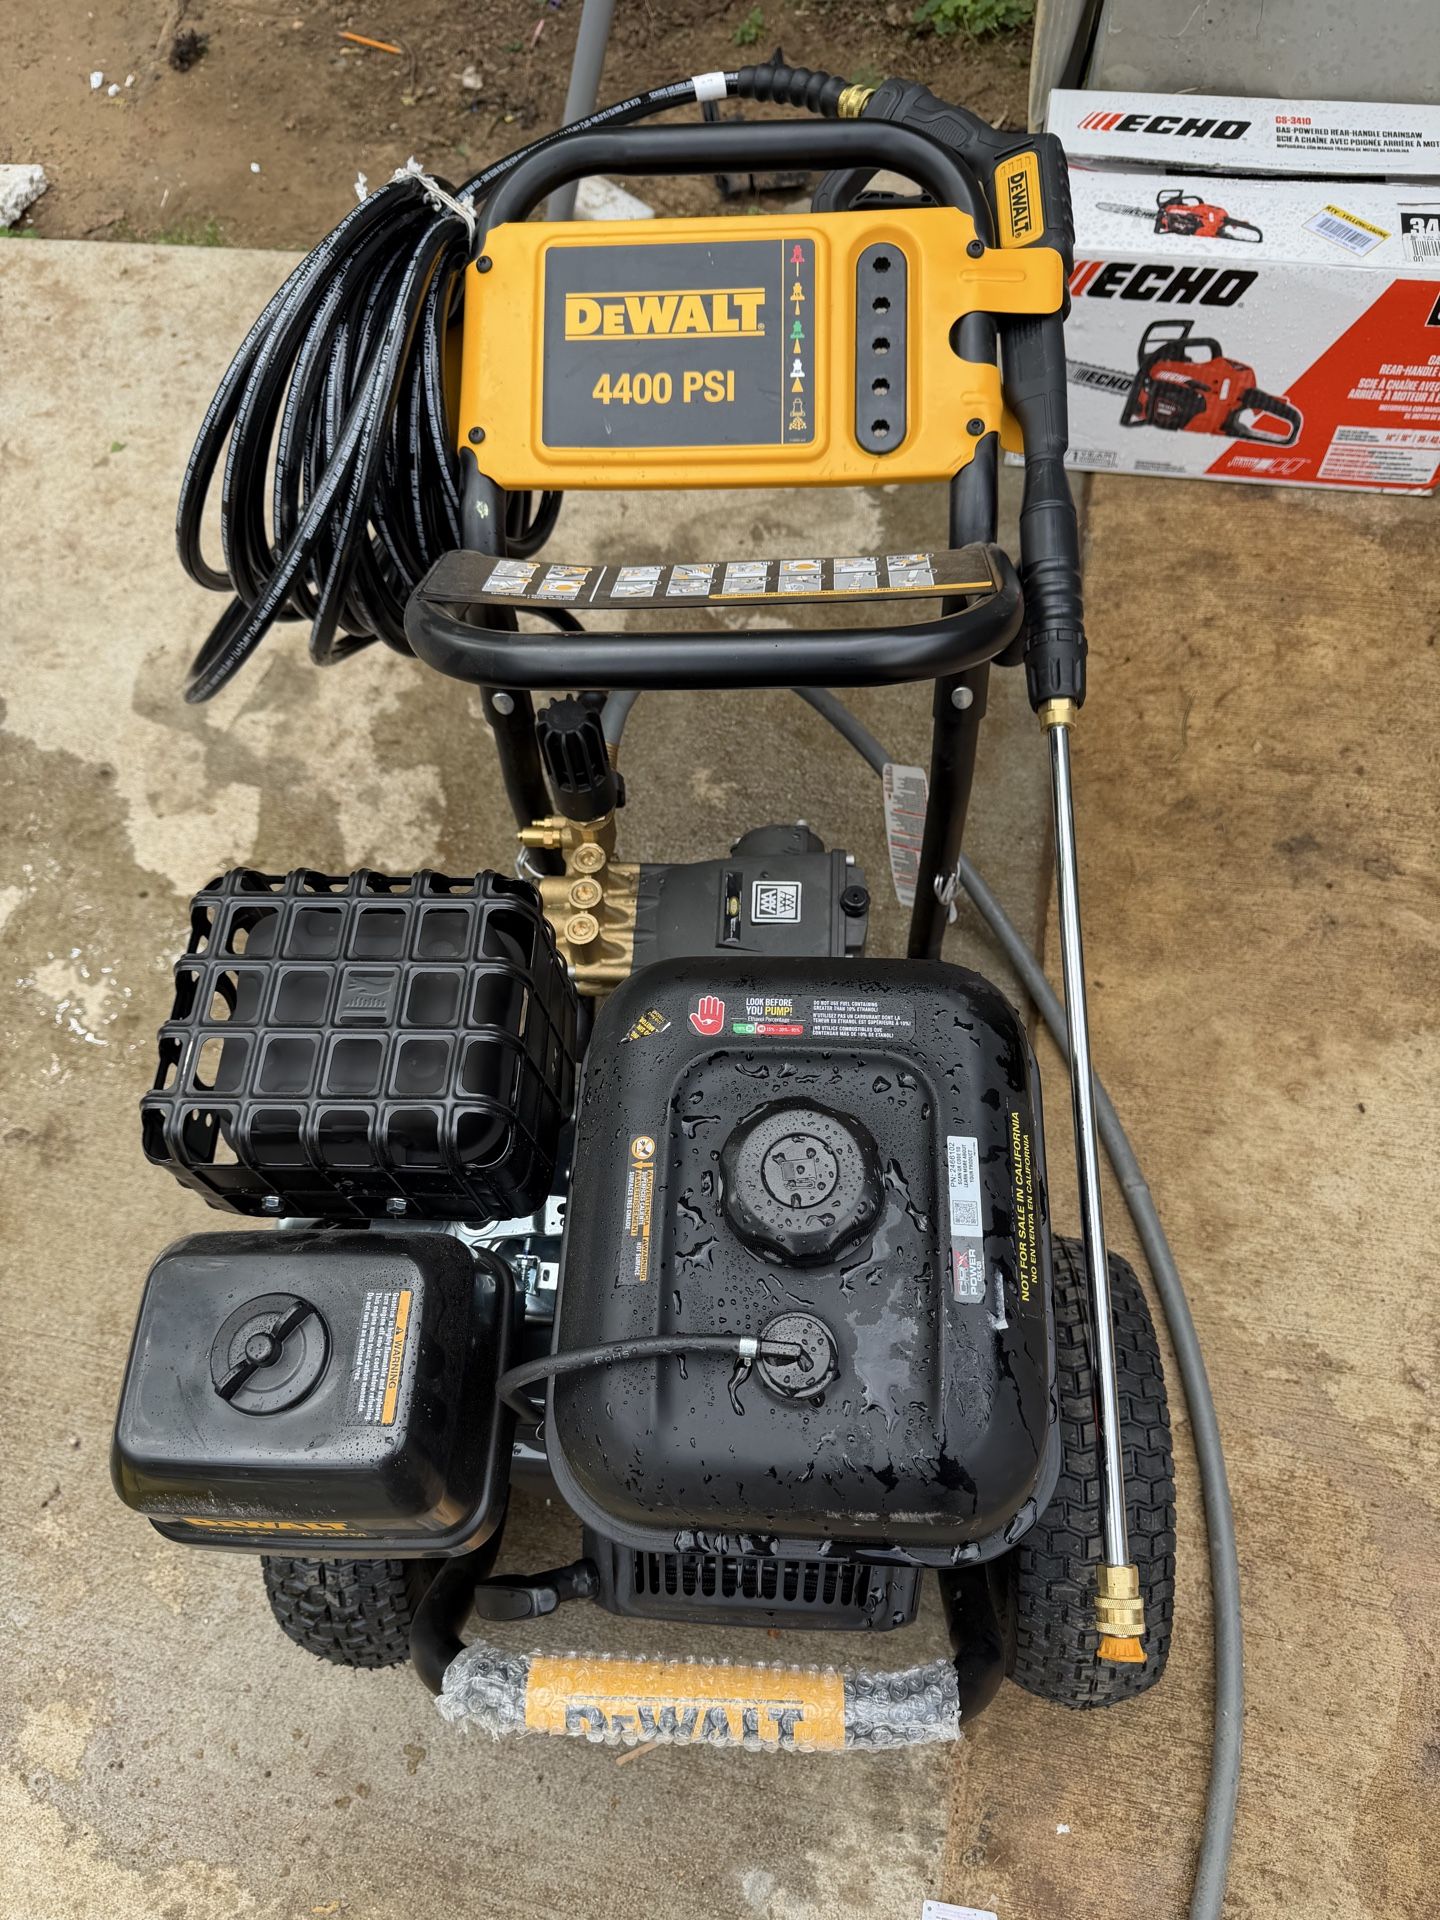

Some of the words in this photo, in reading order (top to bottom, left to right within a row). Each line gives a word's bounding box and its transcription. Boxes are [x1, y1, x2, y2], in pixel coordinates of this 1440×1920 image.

[1114, 114, 1252, 140] ECHO
[1330, 129, 1380, 137] REAR-HANDLE
[1087, 262, 1259, 307] ECHO
[565, 292, 765, 336] DEWALT
[1379, 364, 1439, 377] REAR-HANDLE
[592, 372, 672, 404] 4400
[683, 370, 734, 403] PSI
[302, 512, 321, 540] SURFACES
[746, 998, 764, 1006] LOOK
[765, 998, 793, 1006] BEFORE
[746, 1006, 762, 1016] YOU
[764, 1006, 793, 1016] PUMP!
[1011, 1112, 1023, 1185] CALIFORNIA
[1023, 1134, 1033, 1193] CALIFORNIA
[632, 1179, 640, 1235] AVERTISSEMENT
[644, 1179, 653, 1226] ADVERTENCIA
[1016, 1188, 1024, 1202] IN
[1027, 1196, 1033, 1210] EN
[1017, 1205, 1026, 1239] SALE
[1019, 1242, 1028, 1269] FOR
[1030, 1247, 1037, 1264] EN
[969, 1249, 978, 1295] POWER
[1031, 1266, 1038, 1284] NO
[1020, 1272, 1030, 1301] NOT
[371, 1306, 379, 1325] engine
[380, 1306, 388, 1326] engine
[356, 1338, 366, 1365] enclosed
[366, 1344, 374, 1359] toxic
[374, 1358, 382, 1370] cool
[388, 1340, 403, 1389] WARNING
[363, 1360, 372, 1381] carbon
[370, 1372, 379, 1391] before
